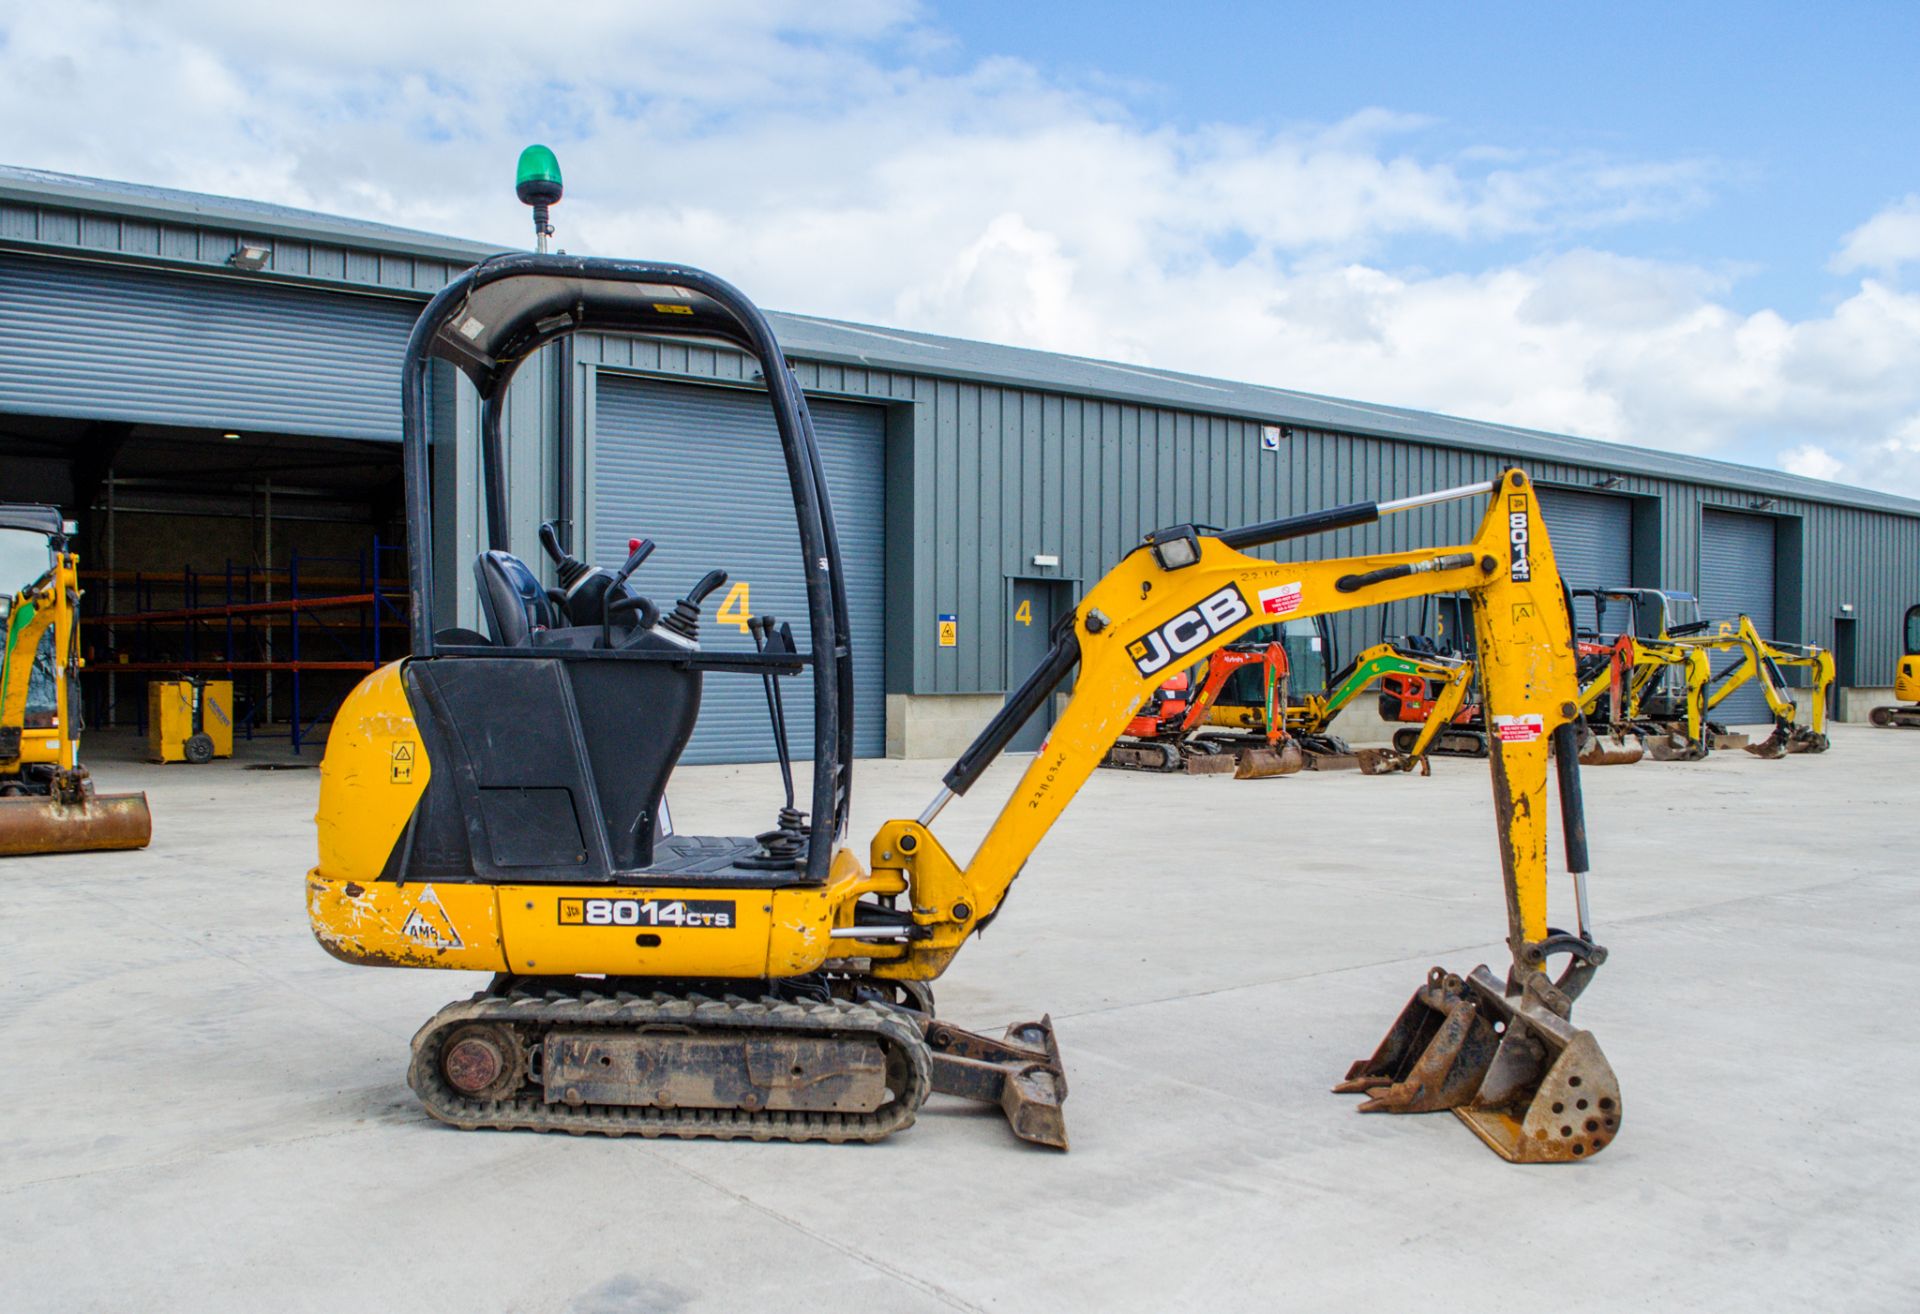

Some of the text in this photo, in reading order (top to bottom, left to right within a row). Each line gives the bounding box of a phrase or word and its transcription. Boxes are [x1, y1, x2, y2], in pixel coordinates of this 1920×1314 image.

[1510, 513, 1529, 574] 8014
[716, 582, 754, 634] 4
[1015, 600, 1033, 627] 4
[1138, 588, 1247, 673] JCB
